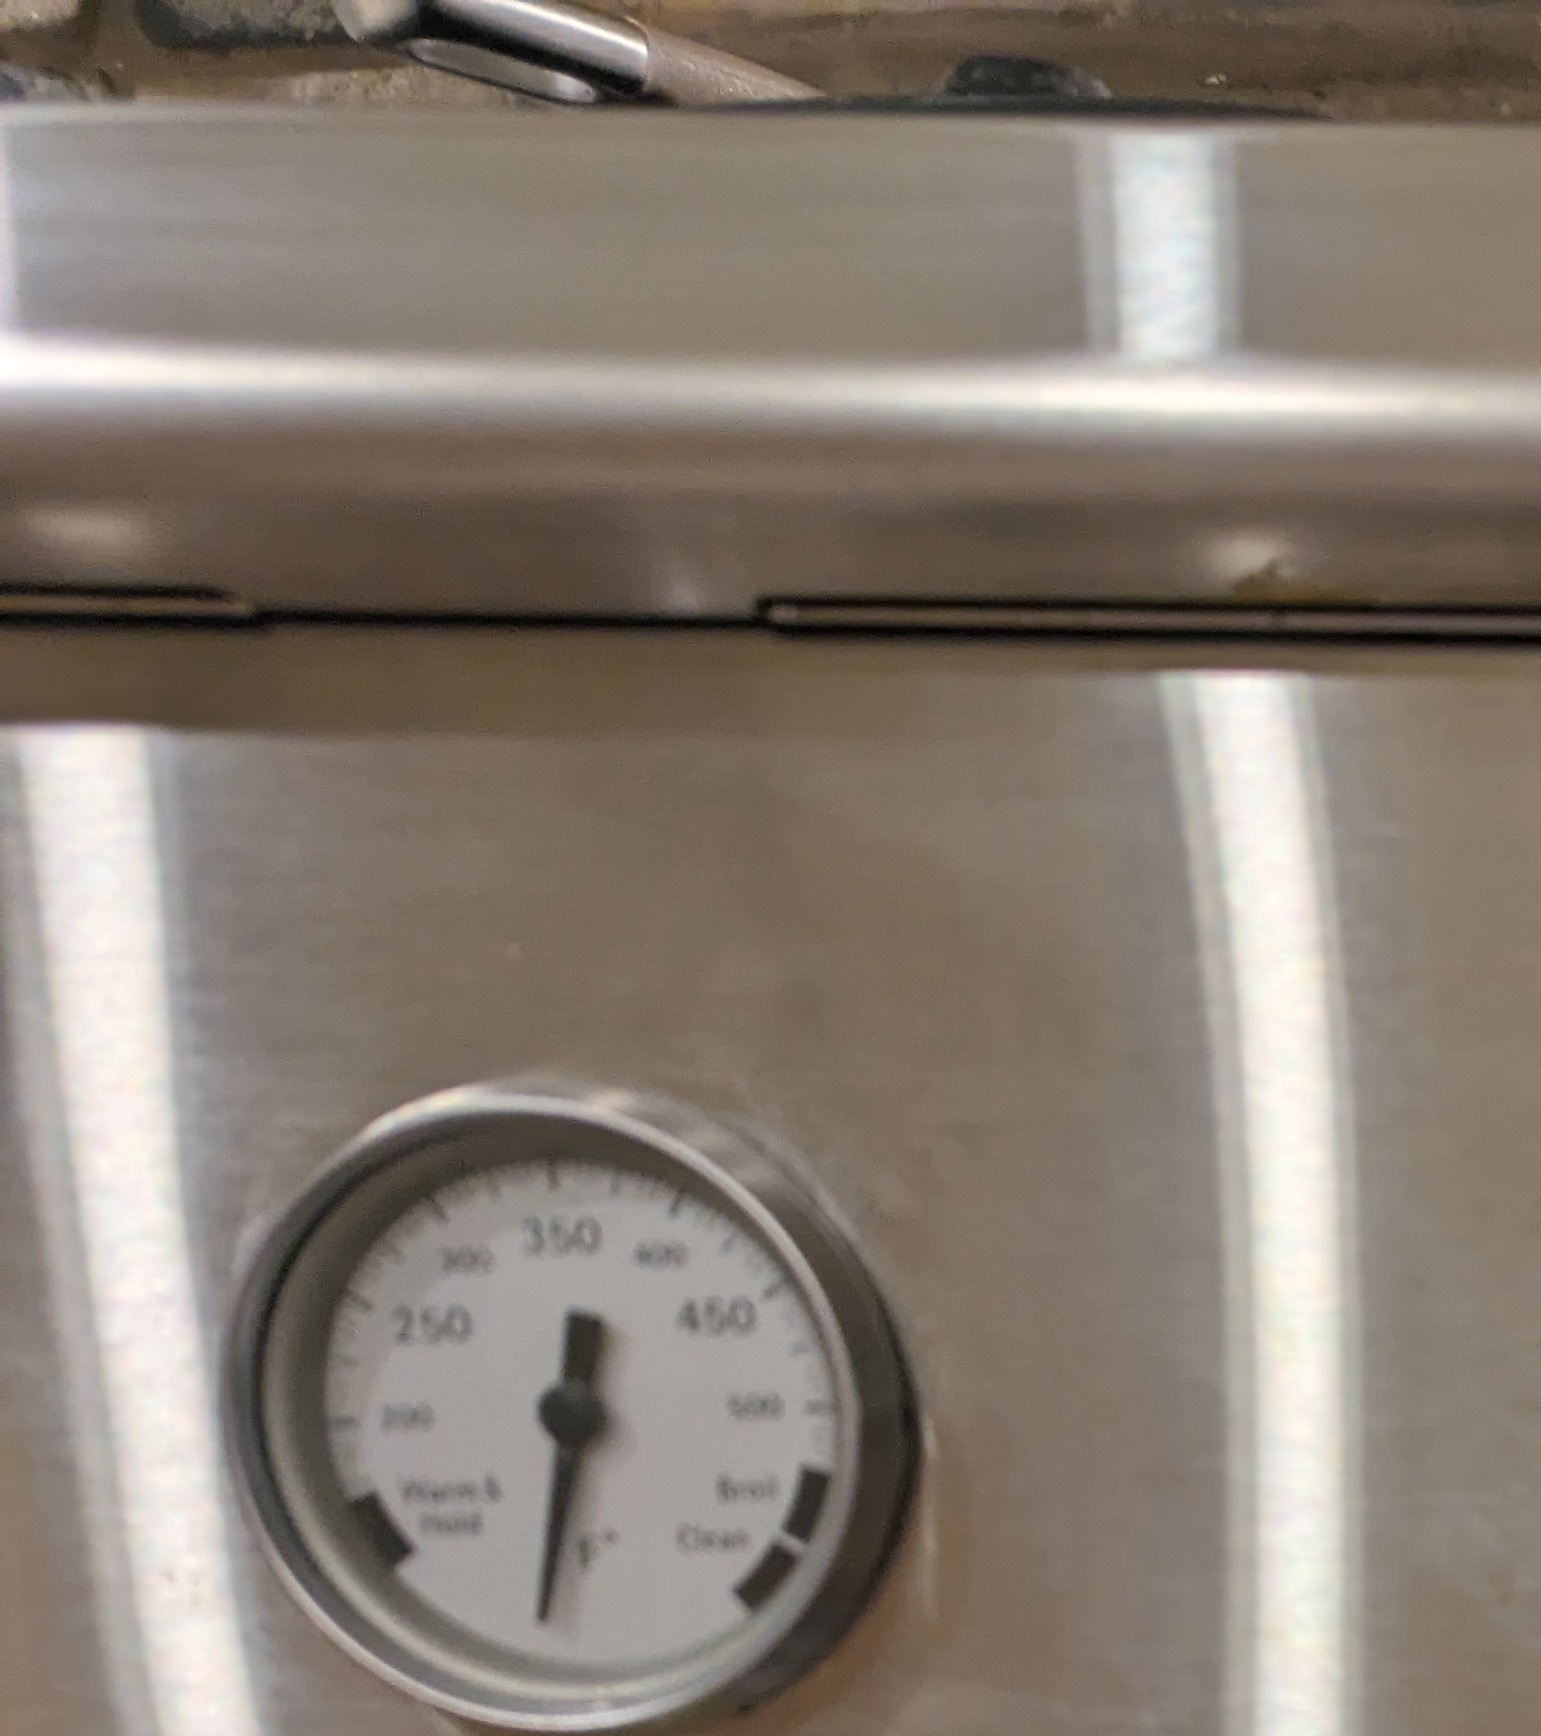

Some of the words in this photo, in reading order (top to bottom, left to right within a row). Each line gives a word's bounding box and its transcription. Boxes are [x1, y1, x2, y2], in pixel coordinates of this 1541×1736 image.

[522, 1215, 603, 1257] 350
[393, 1303, 475, 1345] 250
[677, 1297, 757, 1338] 450
